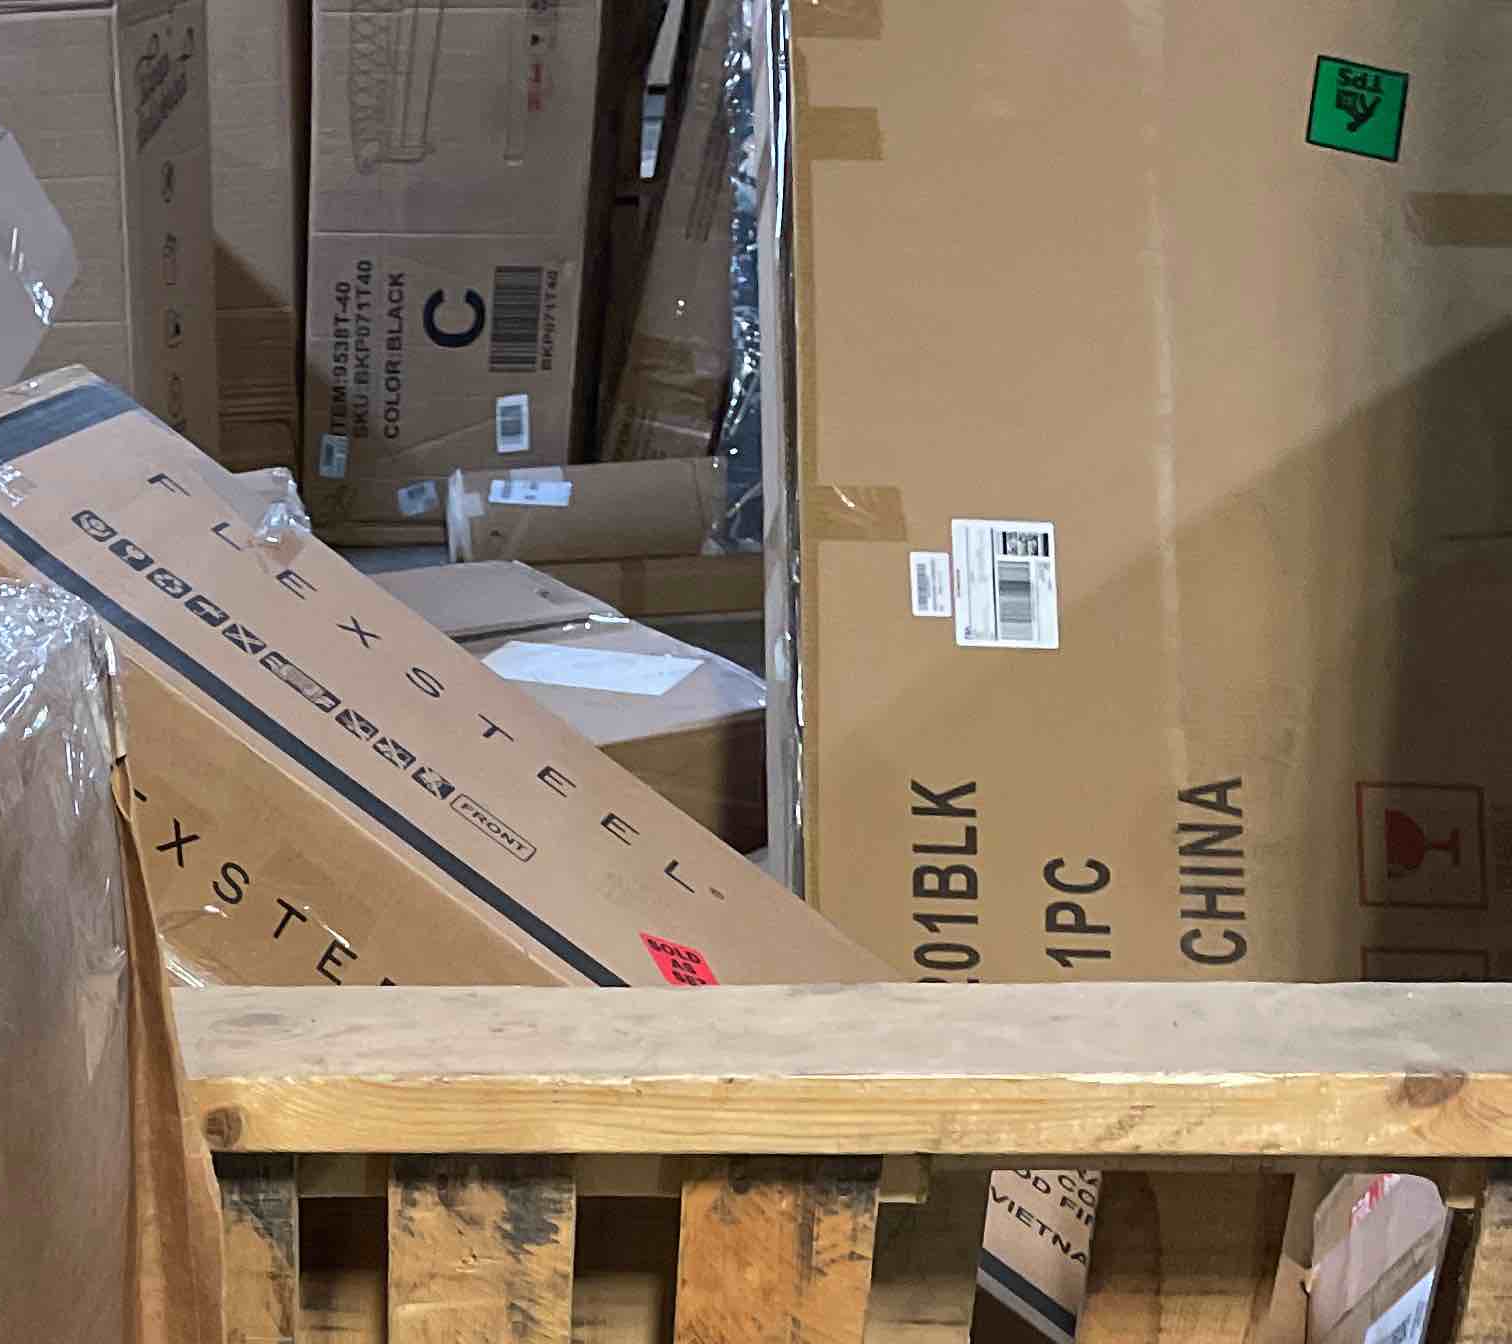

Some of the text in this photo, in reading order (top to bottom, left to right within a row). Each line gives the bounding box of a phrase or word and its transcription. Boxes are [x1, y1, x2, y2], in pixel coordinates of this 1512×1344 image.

[1334, 65, 1386, 95] TPS
[422, 288, 487, 349] C
[459, 799, 527, 853] FRONT
[910, 779, 981, 983] 01BLK
[1176, 776, 1248, 966] CHINA
[1042, 857, 1112, 969] 1PC
[646, 938, 702, 965] SOLD
